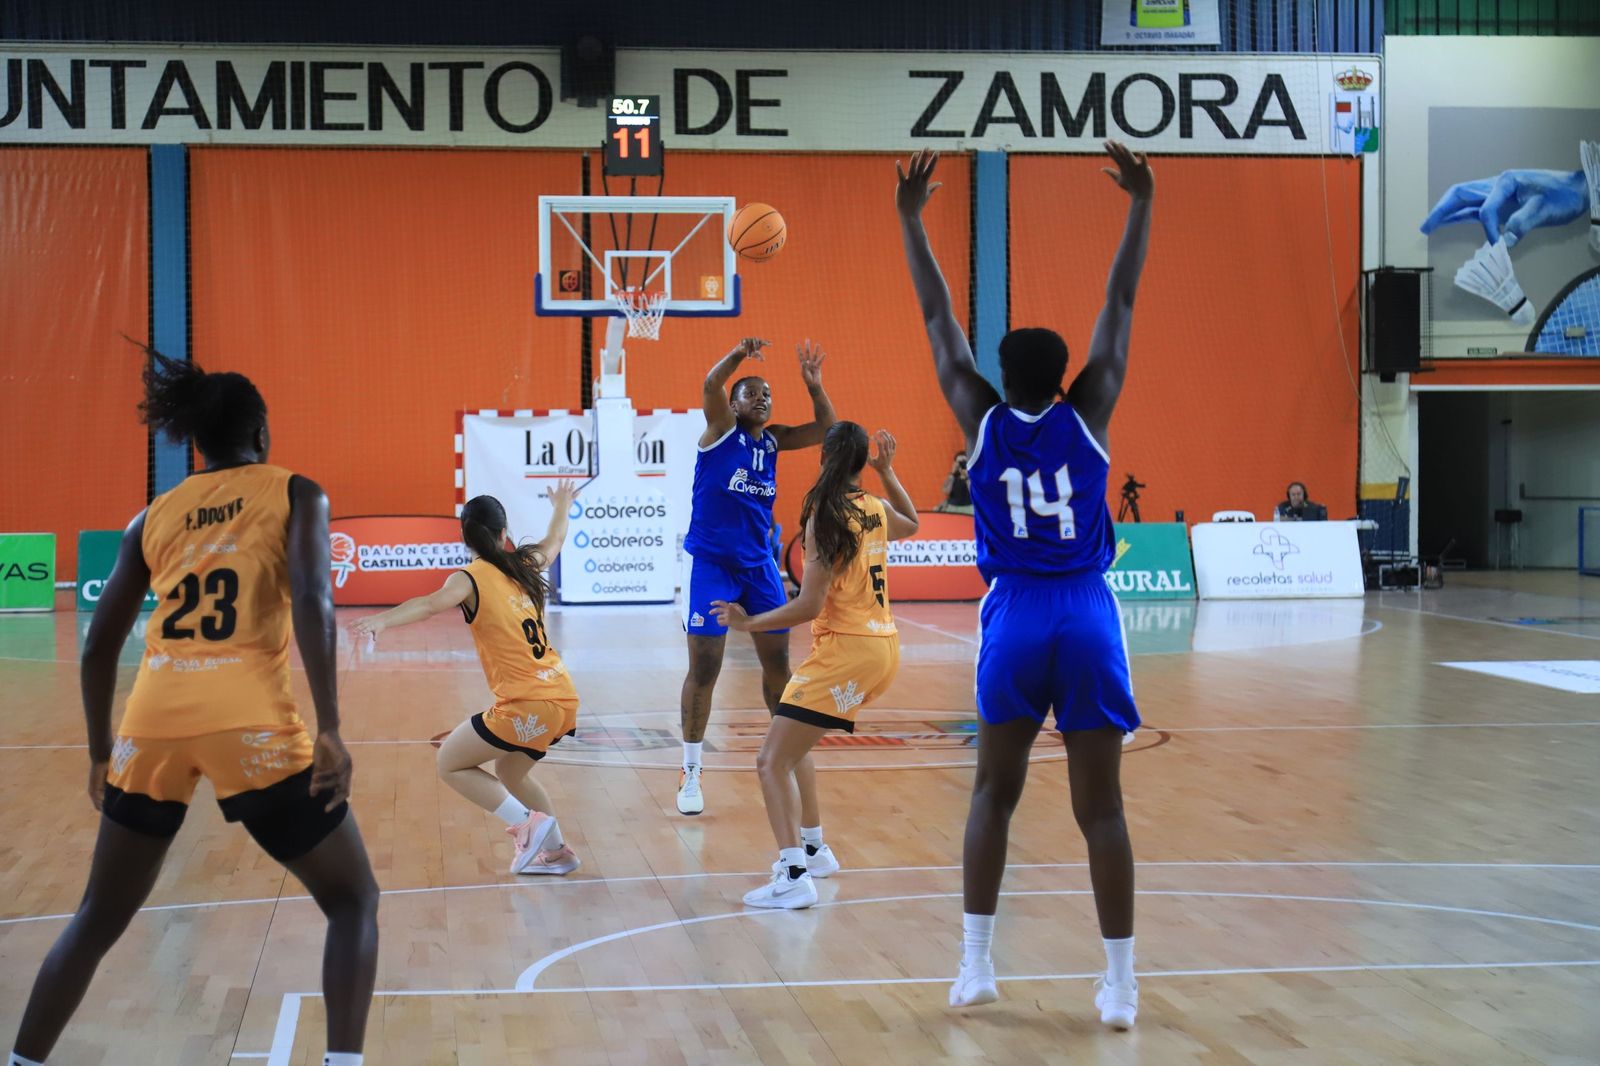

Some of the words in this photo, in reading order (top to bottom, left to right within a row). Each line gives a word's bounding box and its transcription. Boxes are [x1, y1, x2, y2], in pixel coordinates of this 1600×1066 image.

[612, 98, 650, 115] 50.7
[673, 68, 789, 138] DE
[908, 70, 1307, 140] ZAMORA
[613, 127, 650, 158] 11
[525, 430, 555, 466] La
[752, 447, 765, 472] 11
[998, 463, 1076, 540] 14
[585, 504, 666, 519] cobreros
[591, 535, 664, 548] cobreros
[887, 542, 977, 551] LONCEST
[361, 559, 424, 568] CASTILLA
[427, 558, 436, 566] Y
[439, 555, 473, 567] LEÓN
[887, 554, 932, 563] STILLA
[936, 554, 944, 563] Y
[0, 562, 49, 581] AS
[597, 562, 655, 573] cobreros
[1103, 569, 1191, 592] RURAL
[1227, 572, 1293, 586] recoletas
[1298, 571, 1333, 584] salud
[602, 584, 648, 594] cobreros
[161, 567, 239, 642] 23
